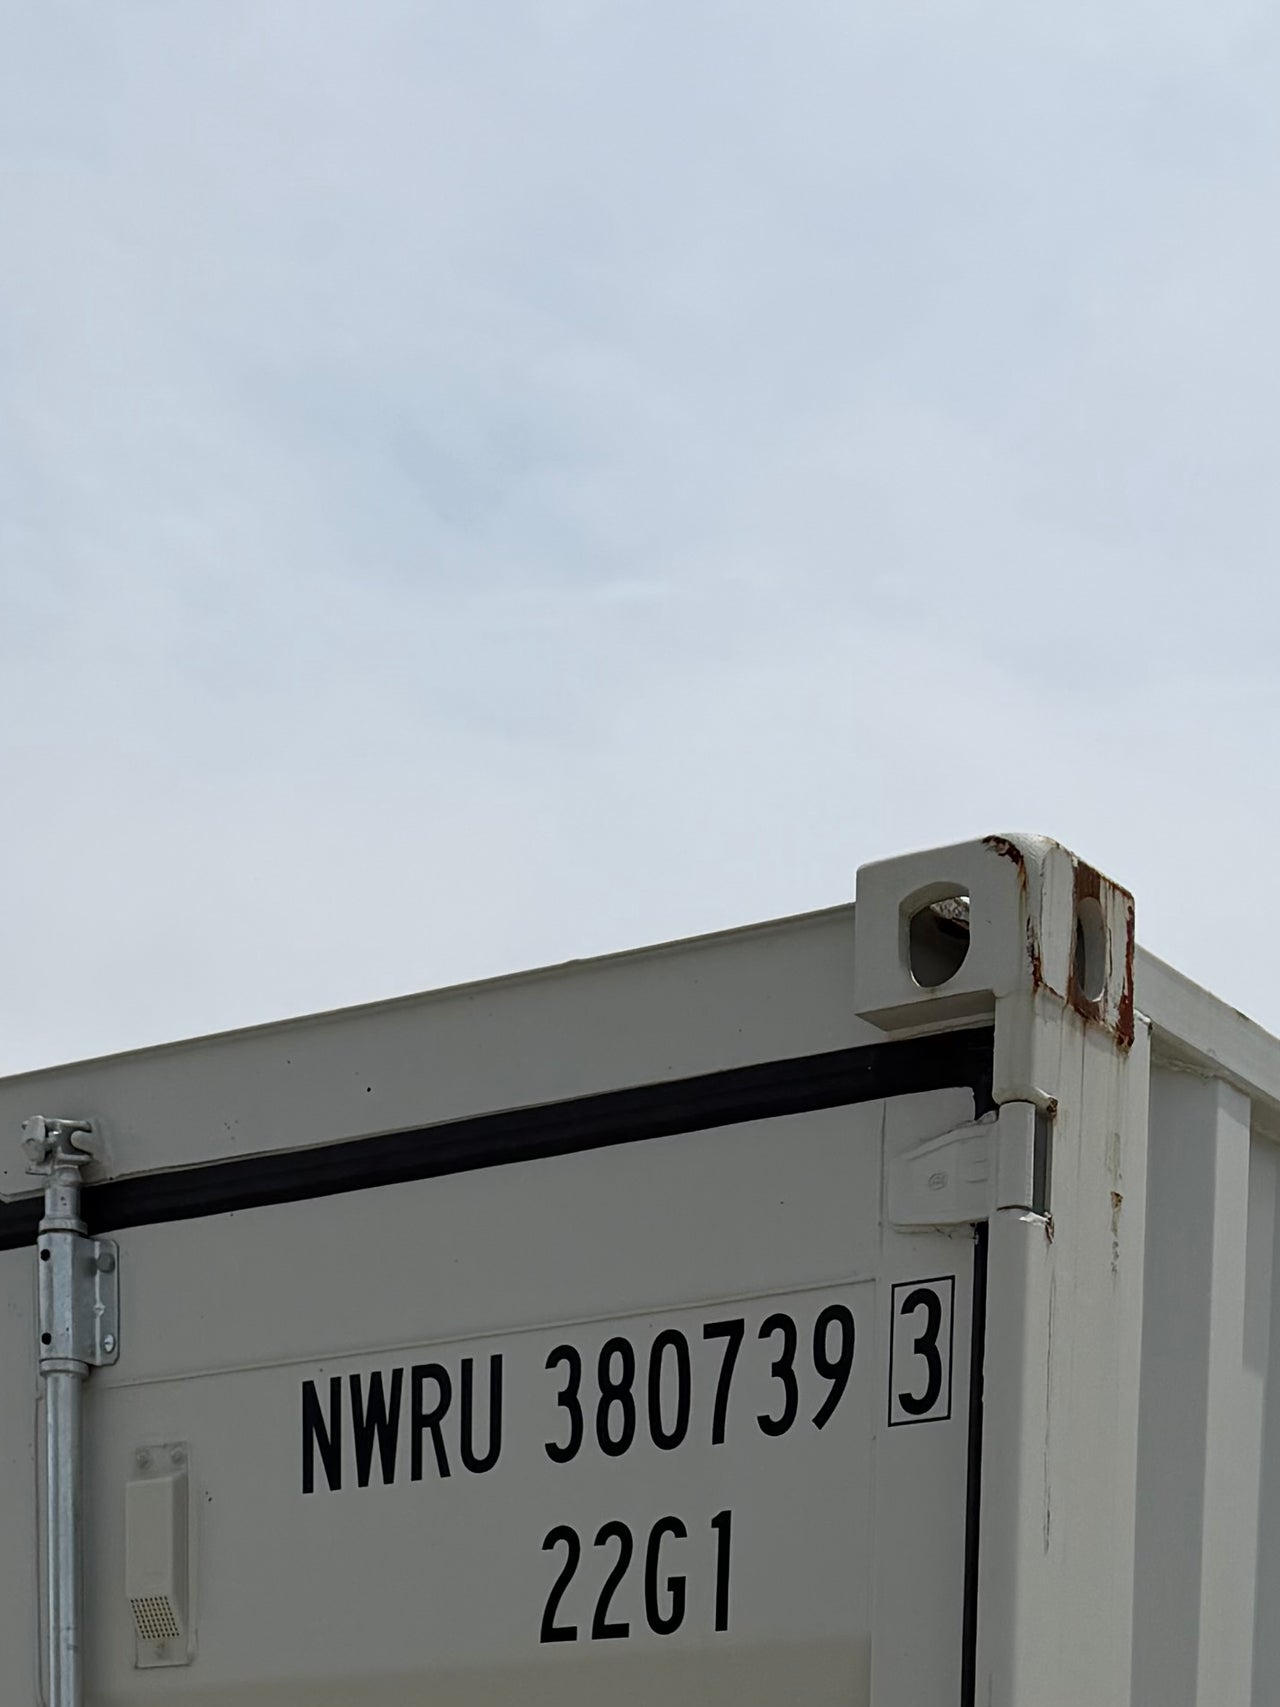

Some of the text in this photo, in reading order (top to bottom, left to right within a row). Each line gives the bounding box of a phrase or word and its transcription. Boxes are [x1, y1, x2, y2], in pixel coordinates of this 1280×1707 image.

[302, 1288, 943, 1494] NWRU 380739 3
[540, 1510, 732, 1644] 22G1
